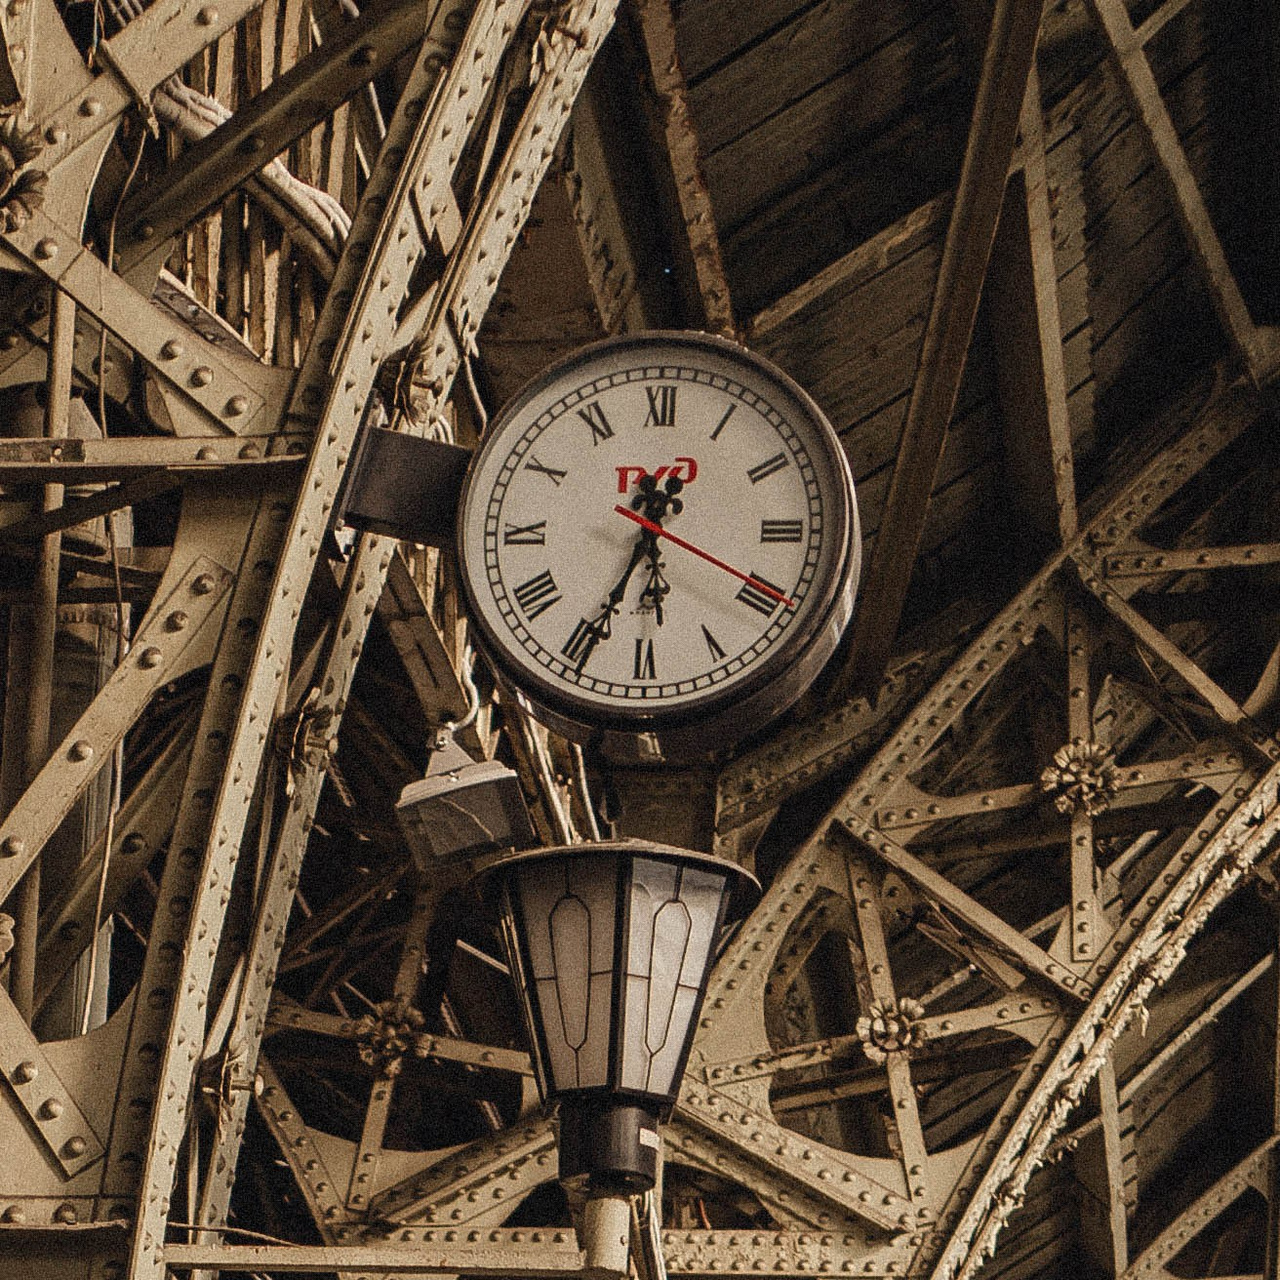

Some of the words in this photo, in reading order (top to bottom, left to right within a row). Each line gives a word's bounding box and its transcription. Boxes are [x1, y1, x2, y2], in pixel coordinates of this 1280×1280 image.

[576, 400, 616, 446] XI
[643, 386, 677, 427] XII
[709, 402, 738, 441] I
[524, 455, 568, 487] X
[747, 452, 791, 484] II
[503, 519, 547, 546] IX
[760, 519, 803, 544] III
[512, 568, 562, 623] VIII
[632, 638, 657, 680] VI
[701, 623, 728, 664] V
